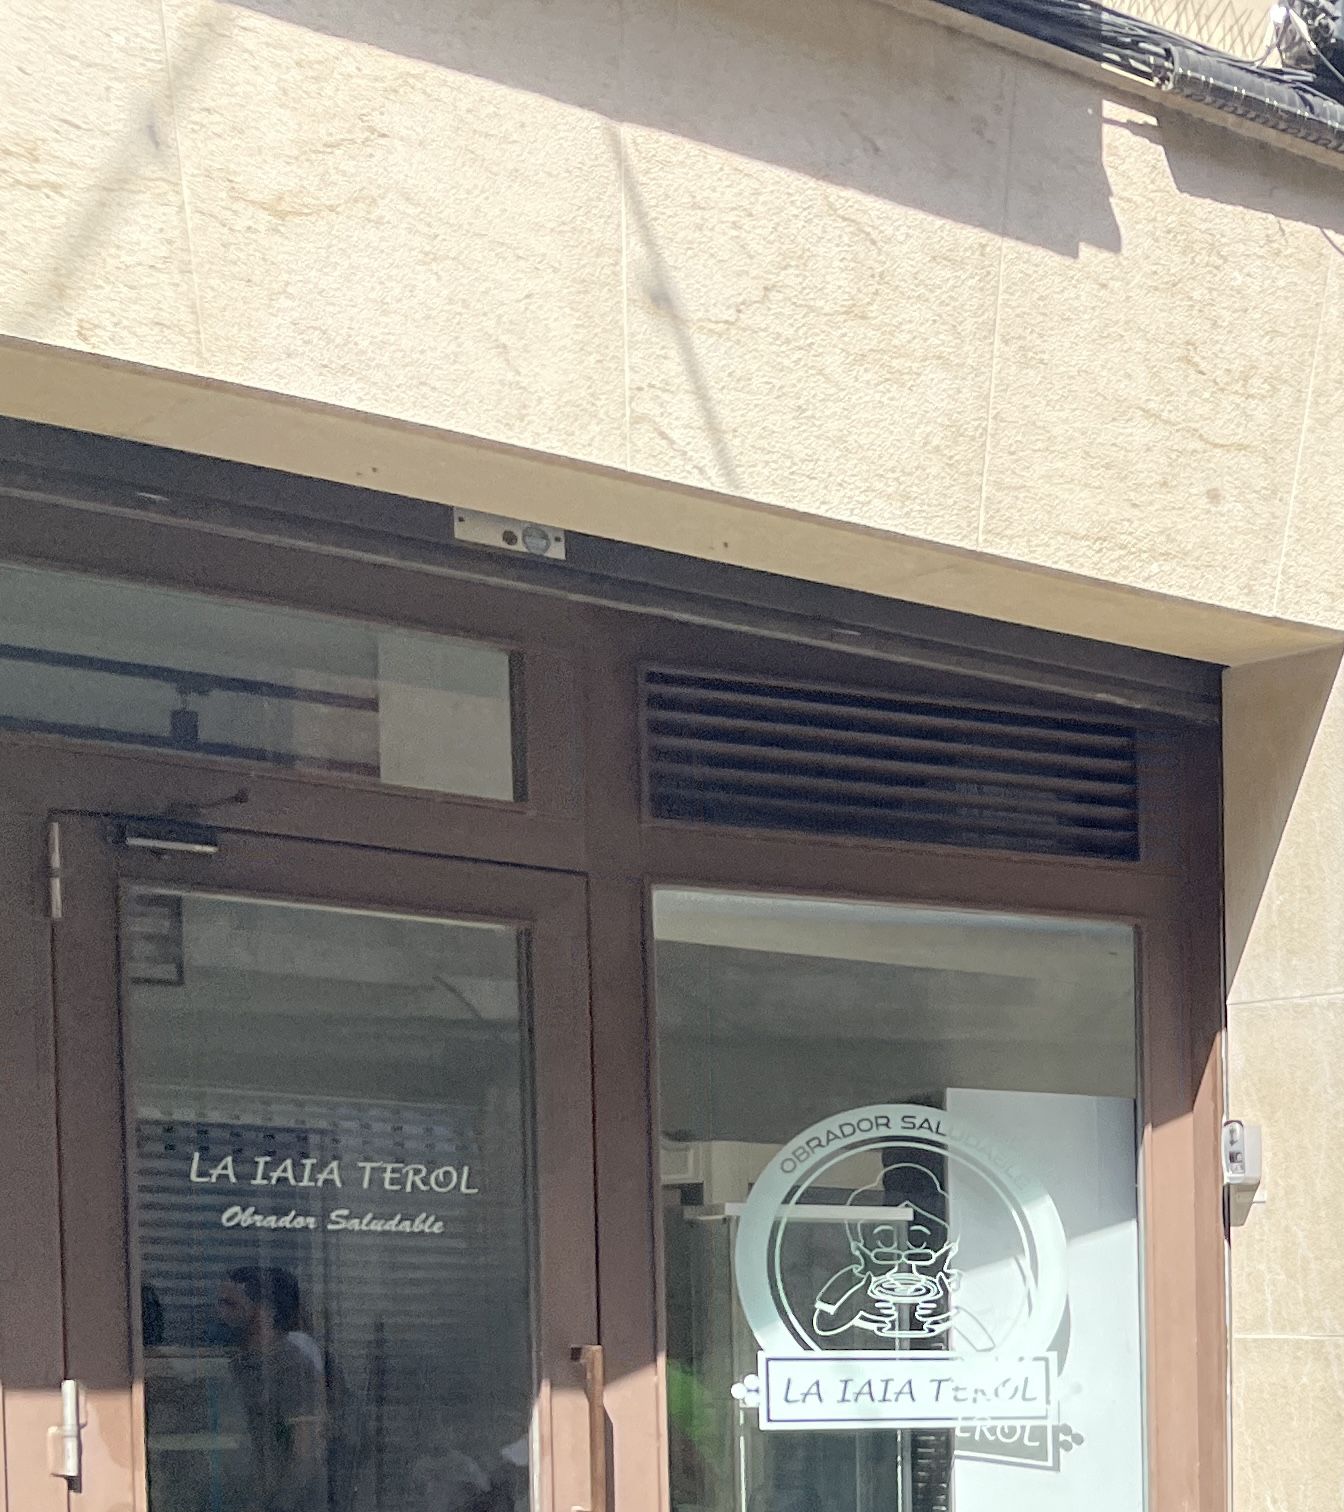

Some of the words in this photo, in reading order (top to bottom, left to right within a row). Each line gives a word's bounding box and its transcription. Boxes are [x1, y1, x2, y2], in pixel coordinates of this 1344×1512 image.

[780, 1115, 891, 1174] OBRADOR
[190, 1152, 238, 1184] LA
[250, 1155, 342, 1189] IAIA
[357, 1160, 479, 1195] TEROL
[220, 1205, 318, 1230] Obrador
[327, 1208, 445, 1234] Saludable
[783, 1377, 823, 1403] LA
[837, 1378, 916, 1403] IAIA
